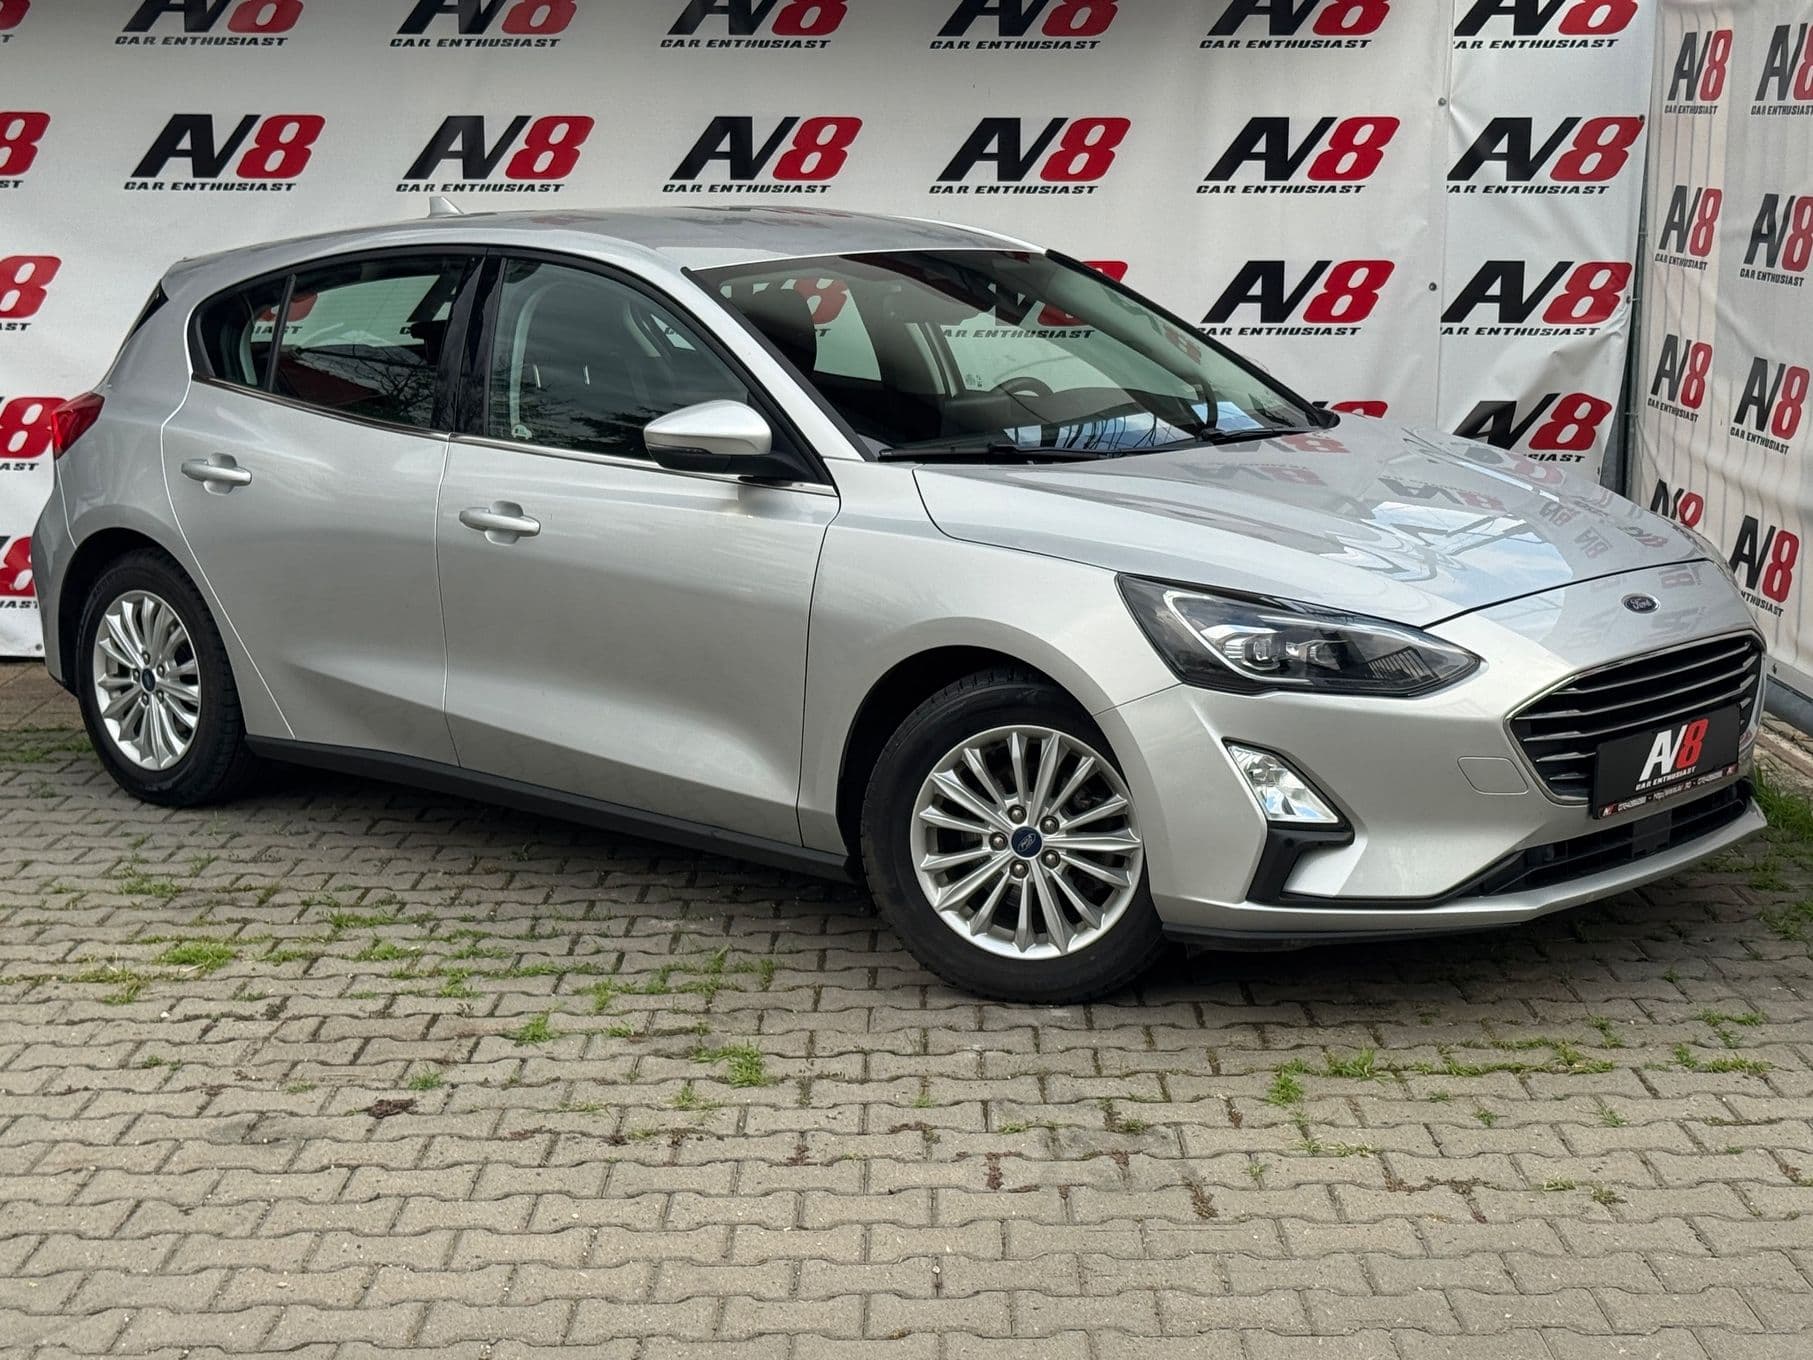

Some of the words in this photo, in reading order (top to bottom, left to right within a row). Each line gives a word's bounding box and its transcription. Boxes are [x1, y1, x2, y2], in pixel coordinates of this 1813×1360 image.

[115, 36, 160, 46] CAR
[162, 36, 289, 46] ENTHUSIAST
[390, 38, 430, 47] CAR
[437, 38, 561, 48] ENTHUSIAST
[660, 39, 699, 48] CAR
[706, 39, 832, 49] ENTHUSIAST
[929, 40, 970, 50] CAR
[976, 40, 1101, 50] ENTHUSIAST
[1200, 39, 1240, 49] CAR
[1246, 39, 1372, 49] ENTHUSIAST
[1453, 39, 1484, 49] AR
[1489, 38, 1619, 49] ENTHUSIAST
[1667, 29, 1733, 102] AV8
[1664, 105, 1677, 114] CAR
[1678, 105, 1718, 115] ENTHUSIAST
[1750, 105, 1767, 116] CAR
[130, 113, 326, 180] AV8
[402, 115, 596, 180] AV8
[669, 115, 864, 181] AV8
[936, 117, 1132, 182] AV8
[1203, 116, 1401, 182] AV8
[1447, 116, 1645, 182] AV8
[124, 181, 164, 191] CAR
[171, 182, 297, 192] ENTHUSIAST
[396, 183, 437, 192] CAR
[441, 183, 565, 193] ENTHUSIAST
[662, 184, 703, 193] CAR
[708, 184, 831, 194] ENTHUSIAST
[929, 185, 970, 195] CAR
[975, 186, 1098, 195] ENTHUSIAST
[1196, 185, 1237, 194] CAR
[1241, 185, 1366, 194] ENTHUSIAST
[1446, 185, 1477, 194] AR
[1482, 185, 1610, 195] ENTHUSIAST
[1658, 185, 1723, 258] AV8
[1743, 193, 1813, 272] AV8
[1655, 253, 1669, 264] CAR
[1669, 256, 1708, 271] ENTHUSIAST
[1739, 268, 1756, 280] CAR
[1756, 270, 1805, 287] ENTHUSIAST
[1200, 259, 1396, 324] AV8
[1440, 260, 1633, 324] AV8
[972, 329, 1095, 339] ENTHUSIAST
[1238, 327, 1361, 336] ENTHUSIAST
[1440, 327, 1470, 336] AR
[1474, 327, 1600, 336] ENTHUSIAST
[1651, 334, 1713, 409] AV8
[1734, 357, 1810, 440] AV8
[1647, 398, 1660, 409] CAR
[1660, 402, 1699, 423] ENTHUSIAST
[1730, 426, 1746, 439] CAR
[1746, 432, 1789, 455] ENTHUSIAST
[1729, 515, 1799, 603] AV8
[1639, 718, 1709, 782] AV8
[1635, 780, 1652, 791] CAR
